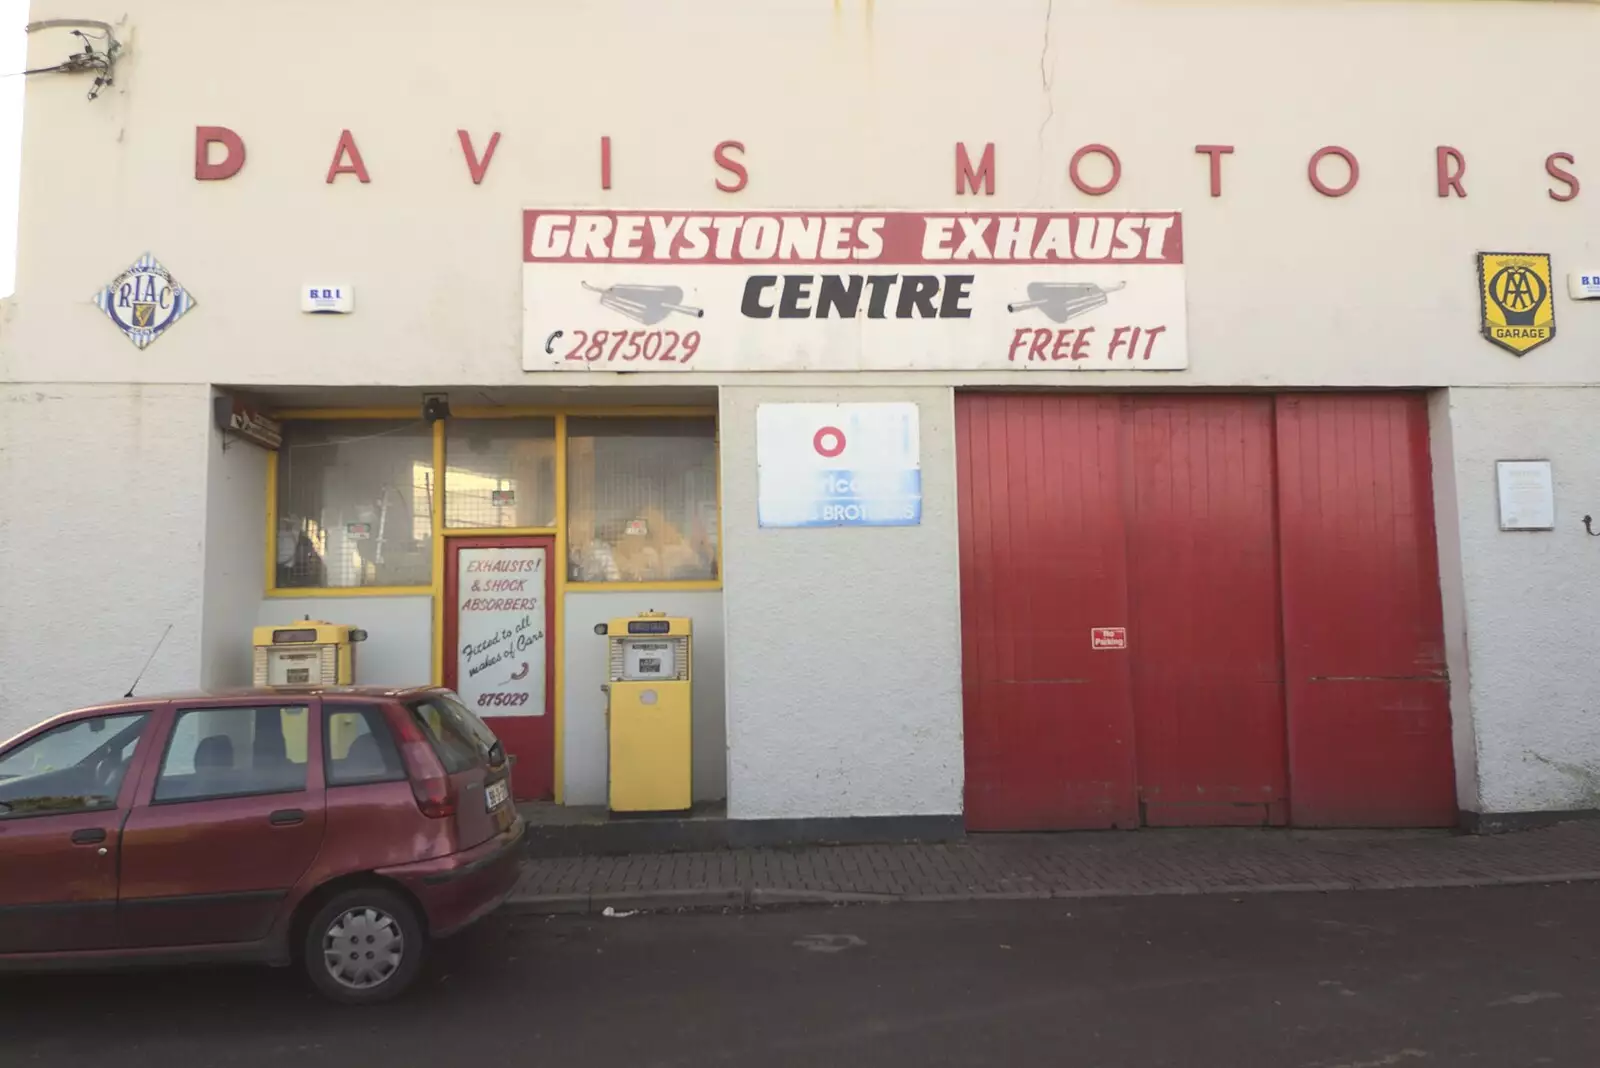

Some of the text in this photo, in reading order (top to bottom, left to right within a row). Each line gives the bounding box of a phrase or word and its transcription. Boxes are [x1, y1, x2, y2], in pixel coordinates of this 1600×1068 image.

[195, 126, 1581, 202] DAVIS MOTORS
[530, 214, 1176, 260] GREYSTONES EXHAUST
[740, 272, 975, 319] CENTRE
[565, 329, 701, 364] 2875029
[1007, 325, 1167, 361] FREE FIT
[1496, 328, 1545, 339] GARAGE
[466, 558, 541, 573] EXHAUSTS!
[471, 579, 528, 592] & SHOCK
[462, 598, 537, 611] ABSORBERS
[462, 615, 531, 662] Fitted to all
[469, 630, 544, 677] makes of Cars
[477, 692, 529, 707] 875029
